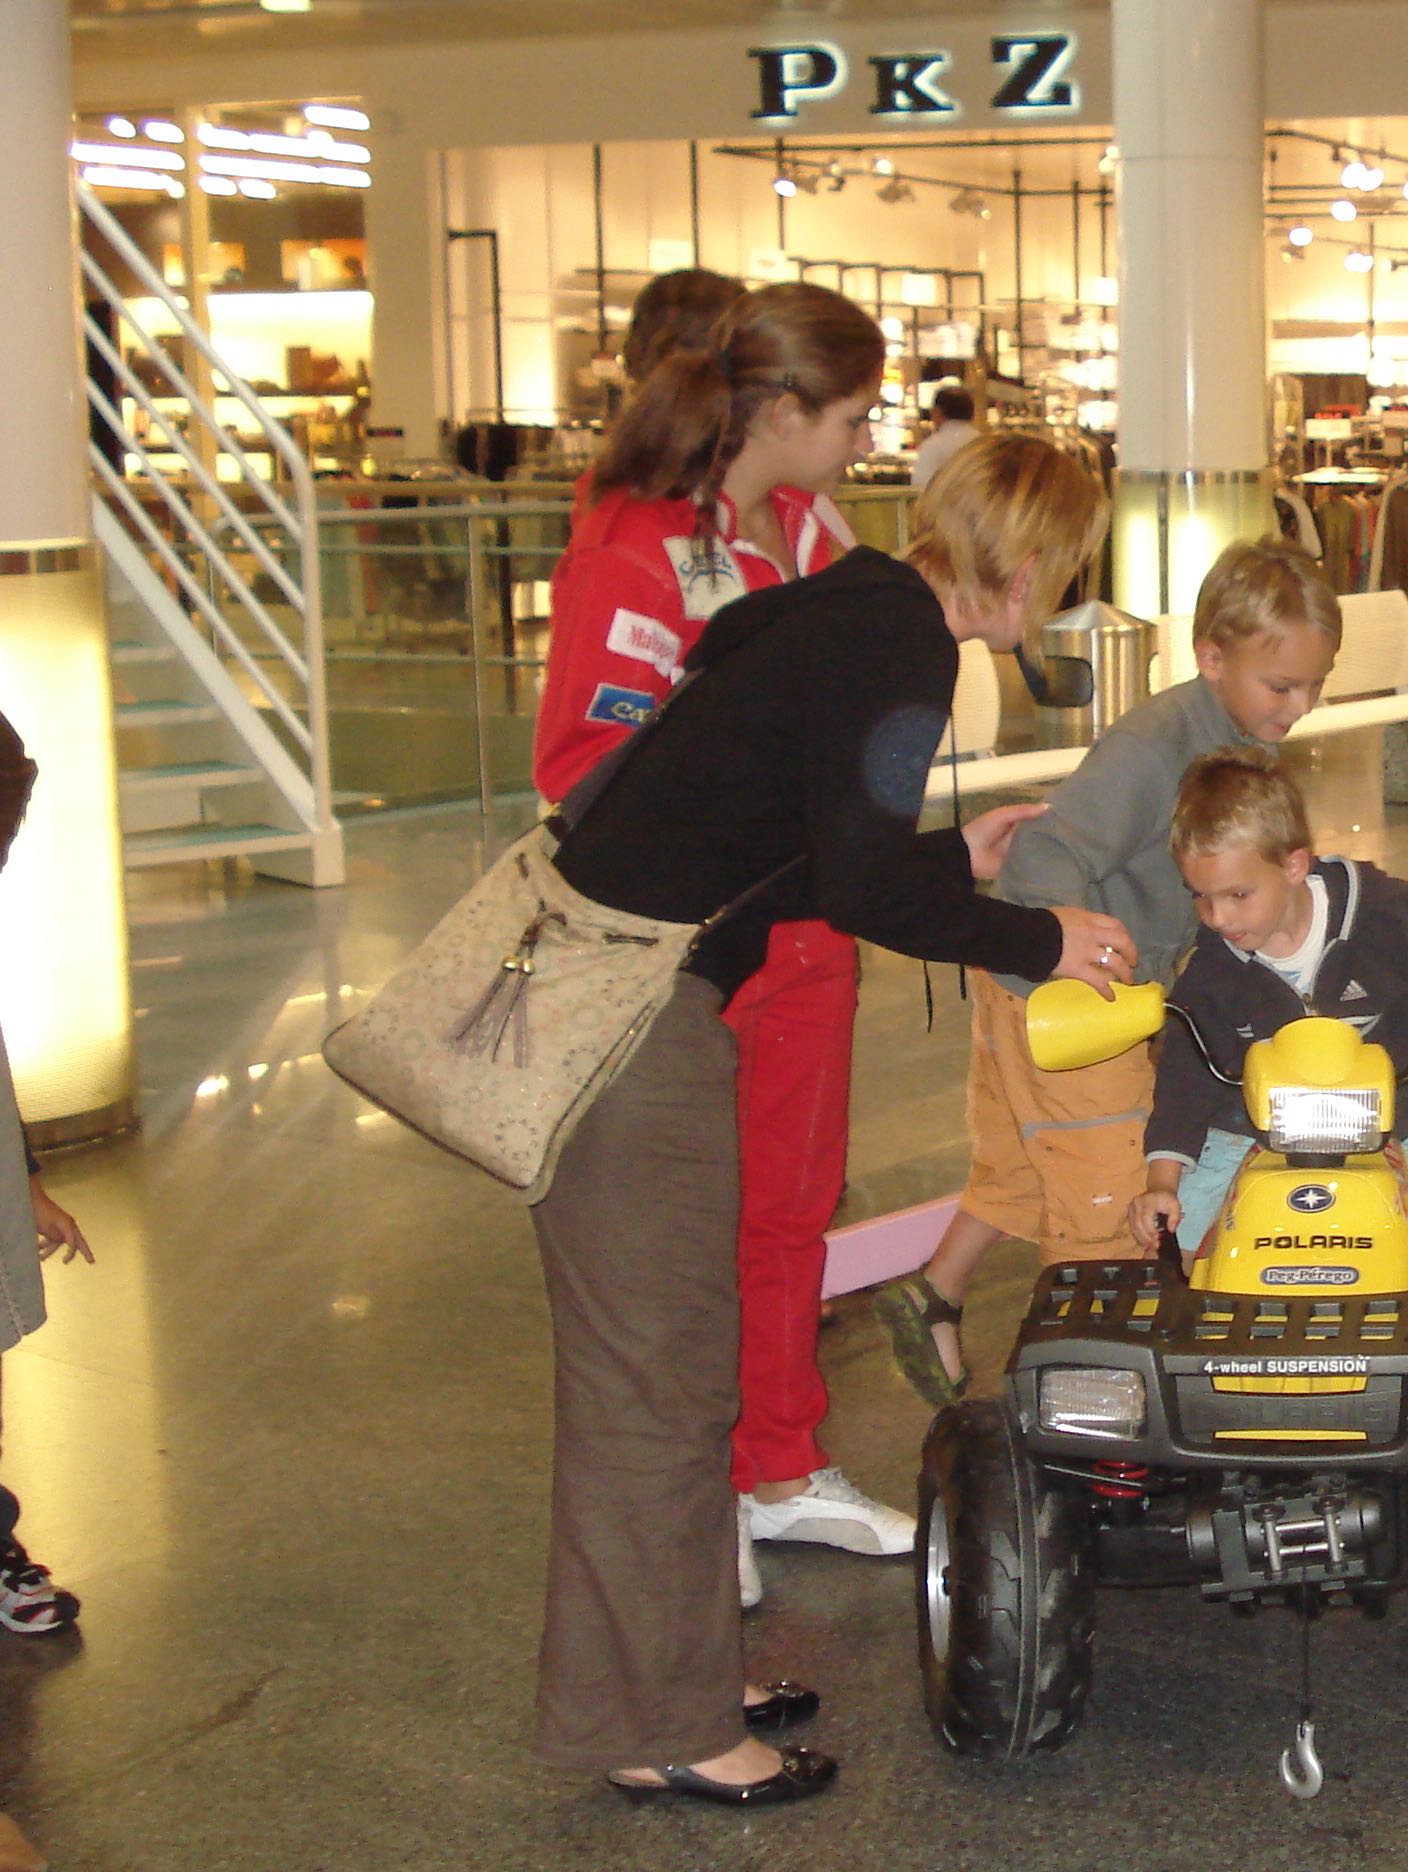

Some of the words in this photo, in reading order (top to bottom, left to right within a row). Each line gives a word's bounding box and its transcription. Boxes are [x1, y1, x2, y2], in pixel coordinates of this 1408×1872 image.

[747, 35, 1074, 118] PKZ
[1253, 1235, 1374, 1251] POLARIS
[1204, 1359, 1262, 1374] 4-wheel
[1266, 1357, 1367, 1374] SUSPENSION
